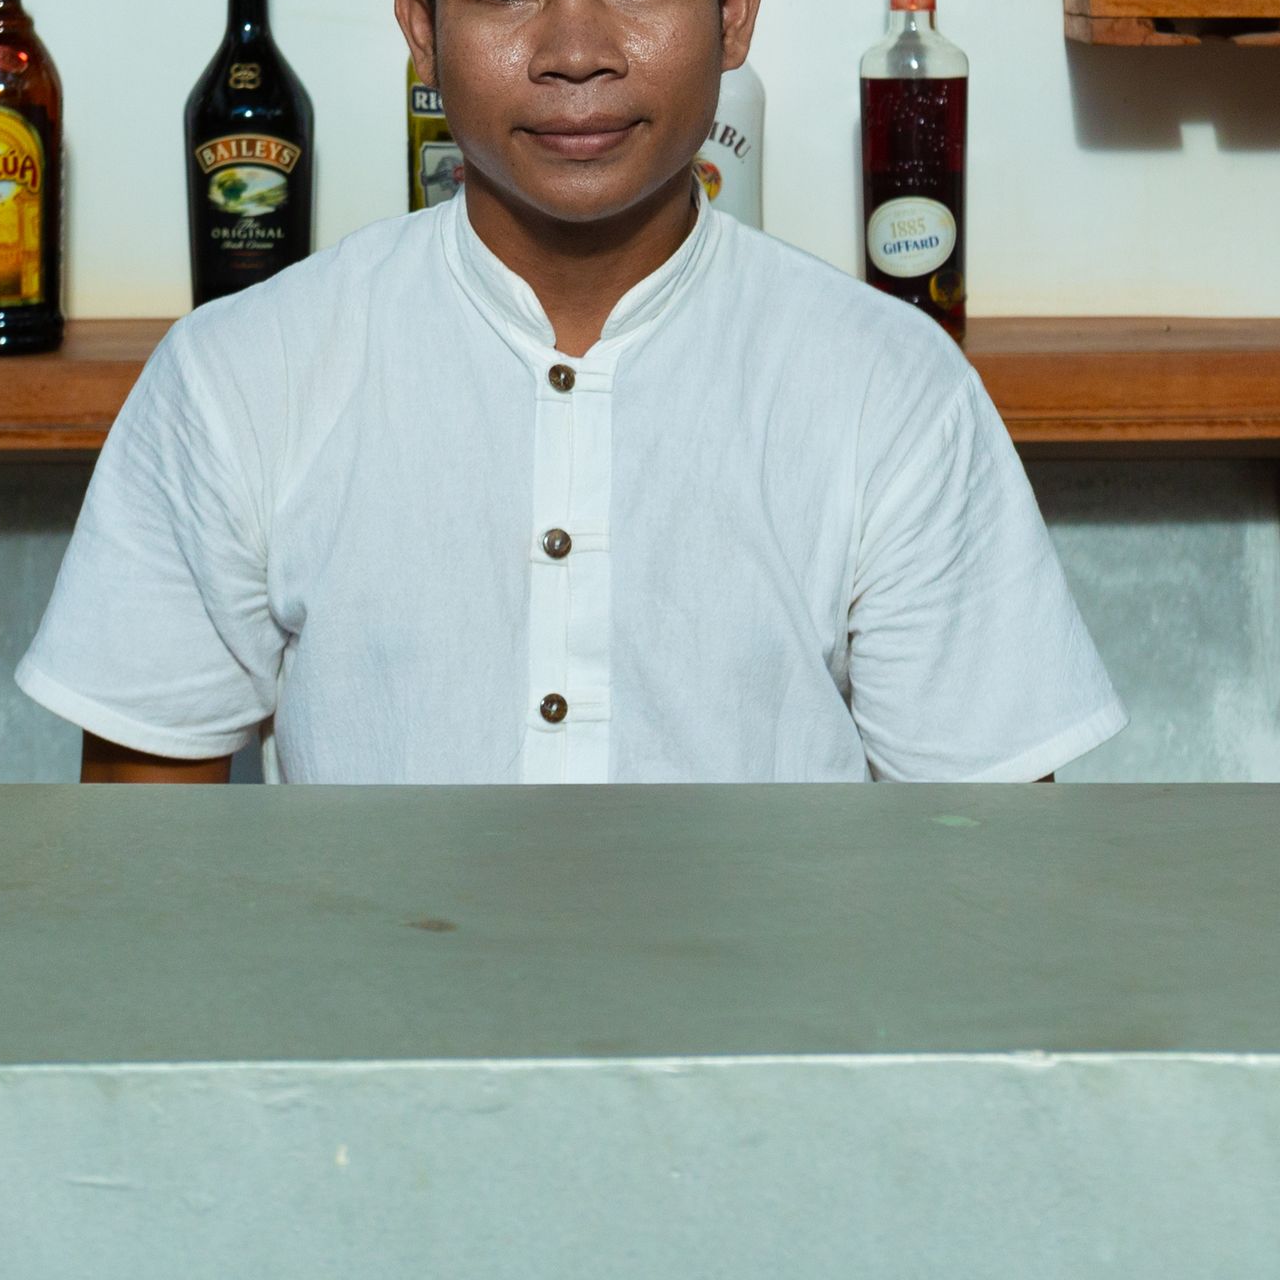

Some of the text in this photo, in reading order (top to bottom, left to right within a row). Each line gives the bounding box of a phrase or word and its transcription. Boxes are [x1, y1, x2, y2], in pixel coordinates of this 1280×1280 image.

[202, 139, 295, 166] BAILEYS
[211, 228, 285, 239] ORIGINAL
[890, 217, 926, 239] 1885
